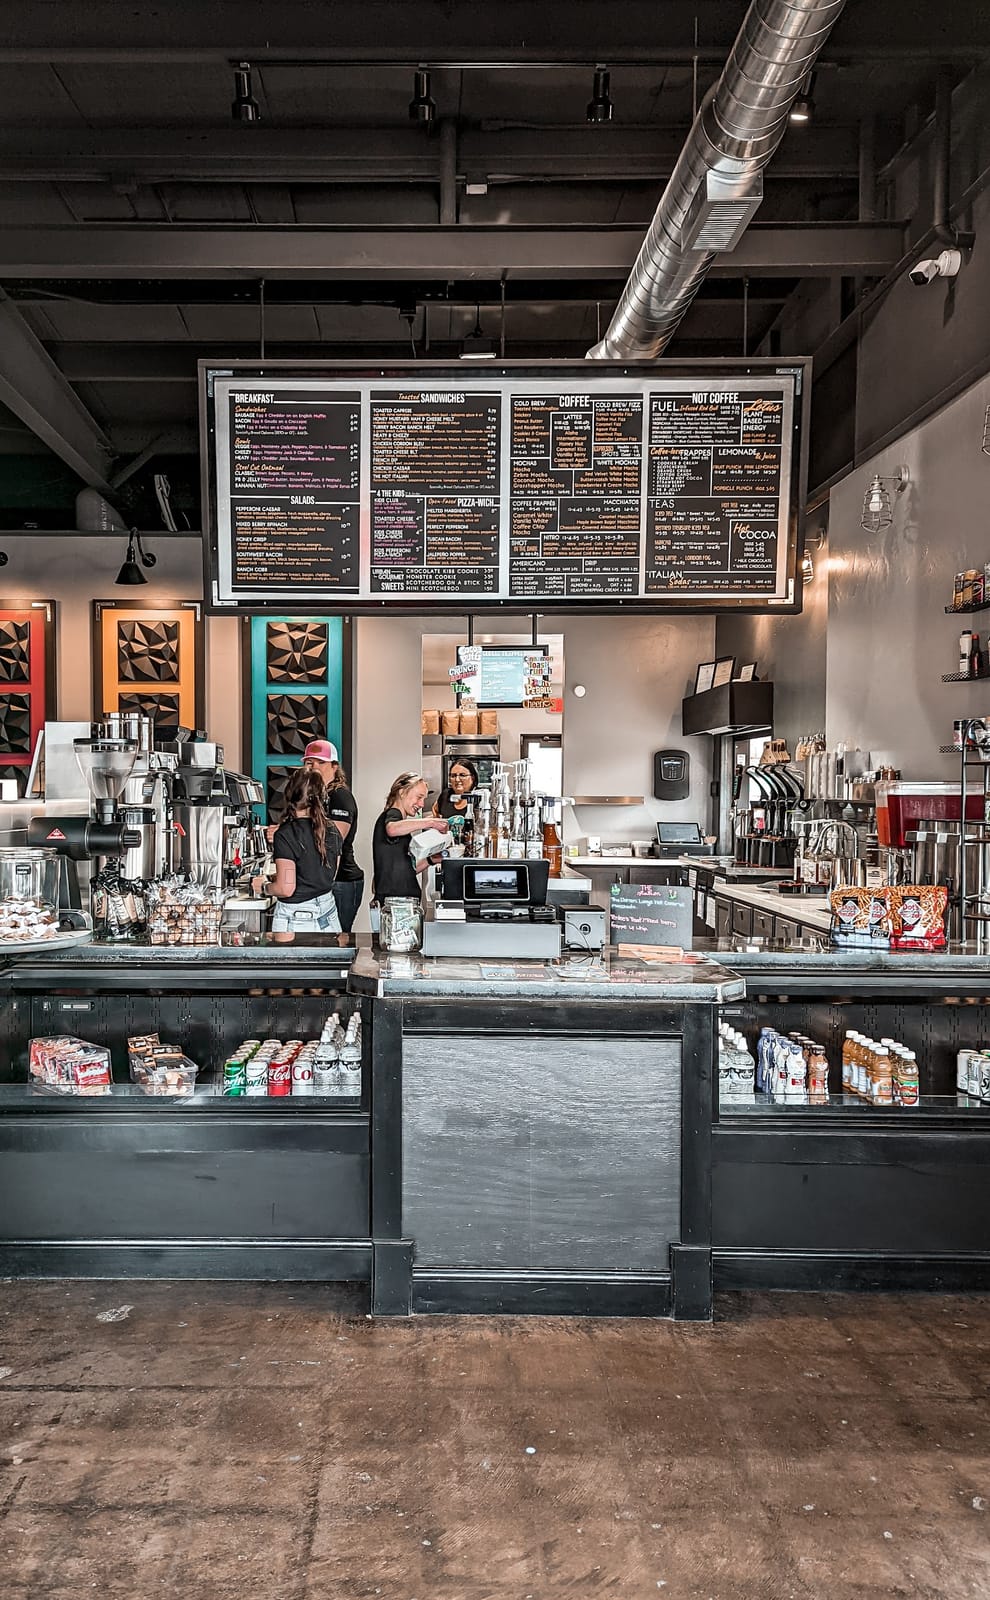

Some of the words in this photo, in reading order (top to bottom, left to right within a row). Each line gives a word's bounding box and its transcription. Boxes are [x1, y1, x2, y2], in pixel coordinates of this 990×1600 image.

[235, 394, 274, 403] BREAKFAST
[421, 394, 464, 403] SANDWICHES
[559, 395, 590, 407] COFFEE
[692, 393, 708, 403] NOT
[710, 393, 739, 403] COFFEE
[652, 402, 679, 411] FUEL
[744, 399, 782, 412] Lotus
[291, 496, 315, 504] SALADS
[458, 498, 494, 507] PIZZA-WICH
[649, 500, 675, 508] TEAS
[733, 522, 750, 534] Hot
[740, 531, 776, 539] COCOA
[381, 583, 404, 591] SWEETS
[451, 682, 471, 694] Trix
